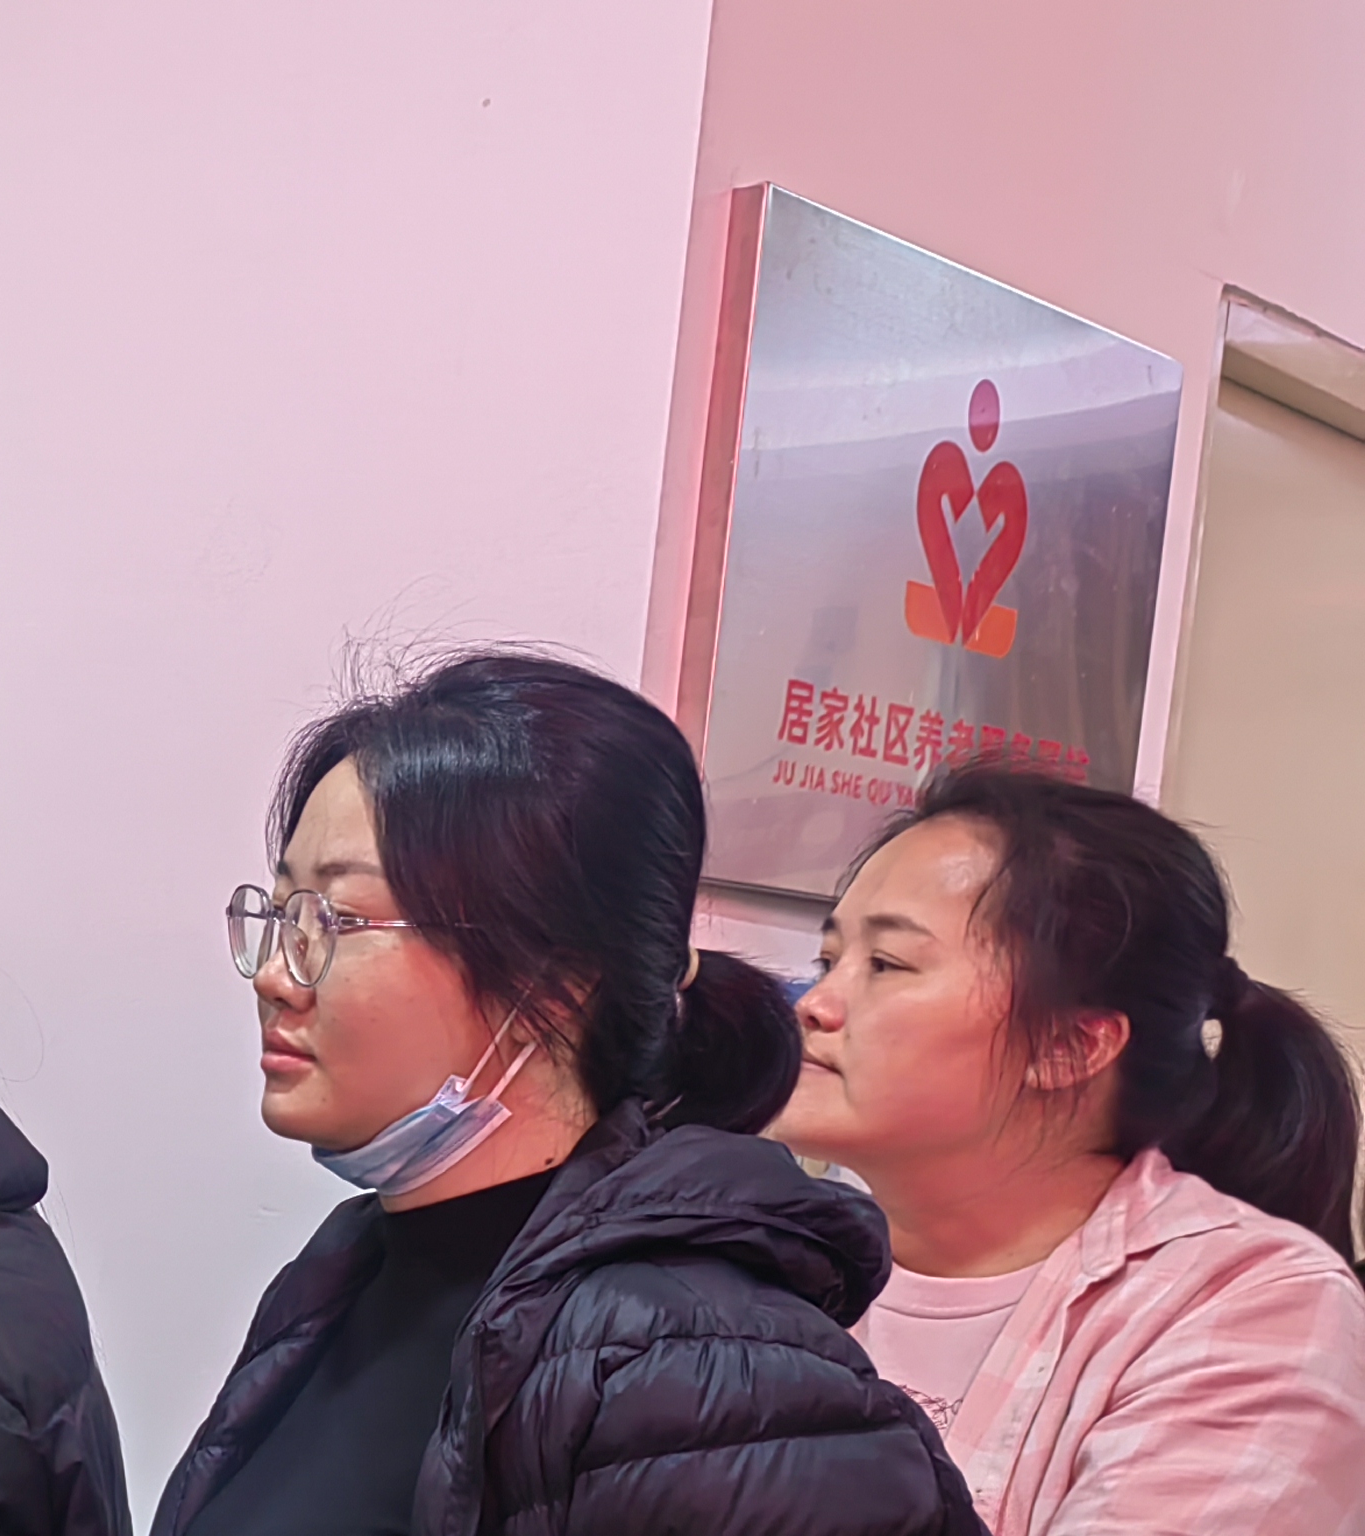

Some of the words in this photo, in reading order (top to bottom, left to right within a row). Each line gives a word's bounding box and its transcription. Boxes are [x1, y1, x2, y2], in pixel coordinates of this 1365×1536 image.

[772, 760, 796, 785] JU
[799, 764, 825, 792] JIA
[831, 770, 863, 799] SHE
[867, 778, 892, 804] QU
[896, 783, 916, 806] YA
